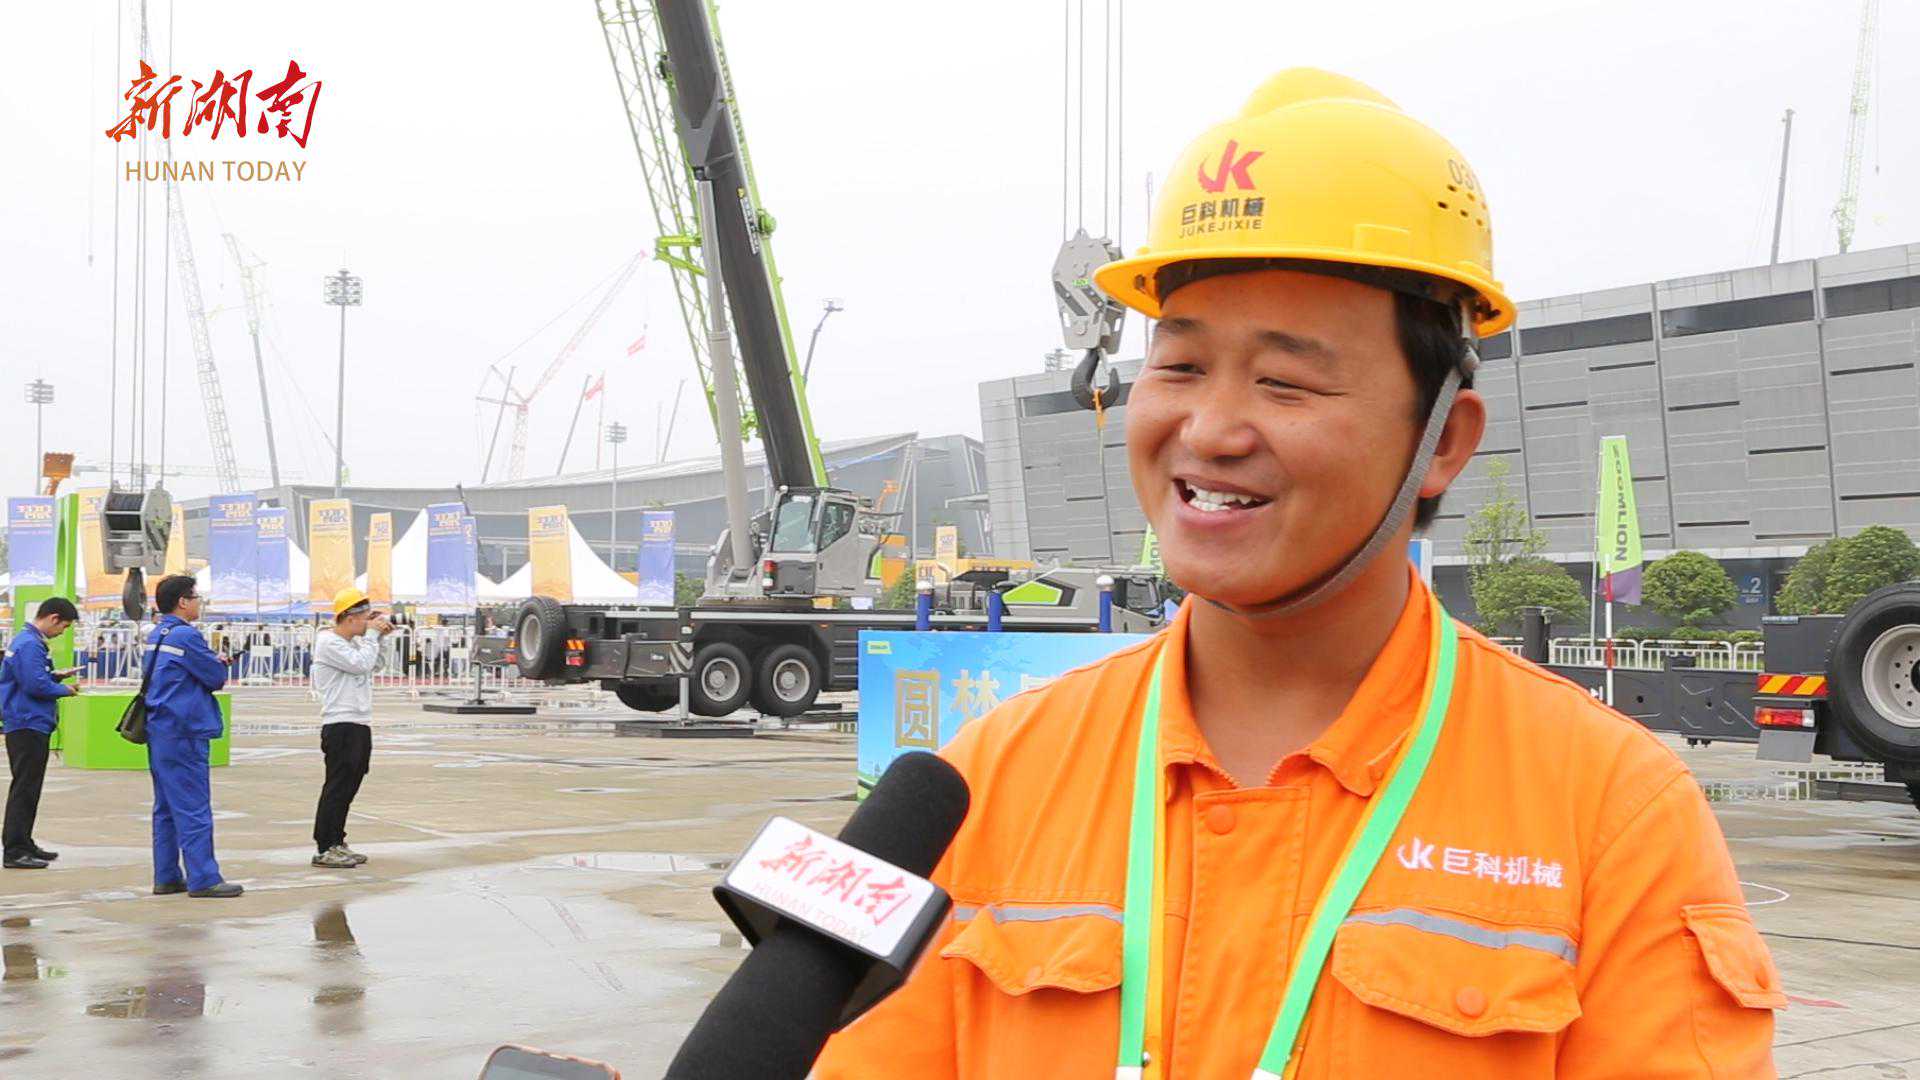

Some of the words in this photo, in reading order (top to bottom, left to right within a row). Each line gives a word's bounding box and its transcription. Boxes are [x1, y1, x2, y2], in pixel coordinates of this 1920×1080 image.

[1179, 219, 1263, 239] JUKEJIXIE
[1180, 197, 1265, 226] 巨科机械
[1612, 444, 1628, 562] ZOOMLION
[760, 834, 913, 927] 新湖南
[1442, 847, 1564, 888] 巨科机械
